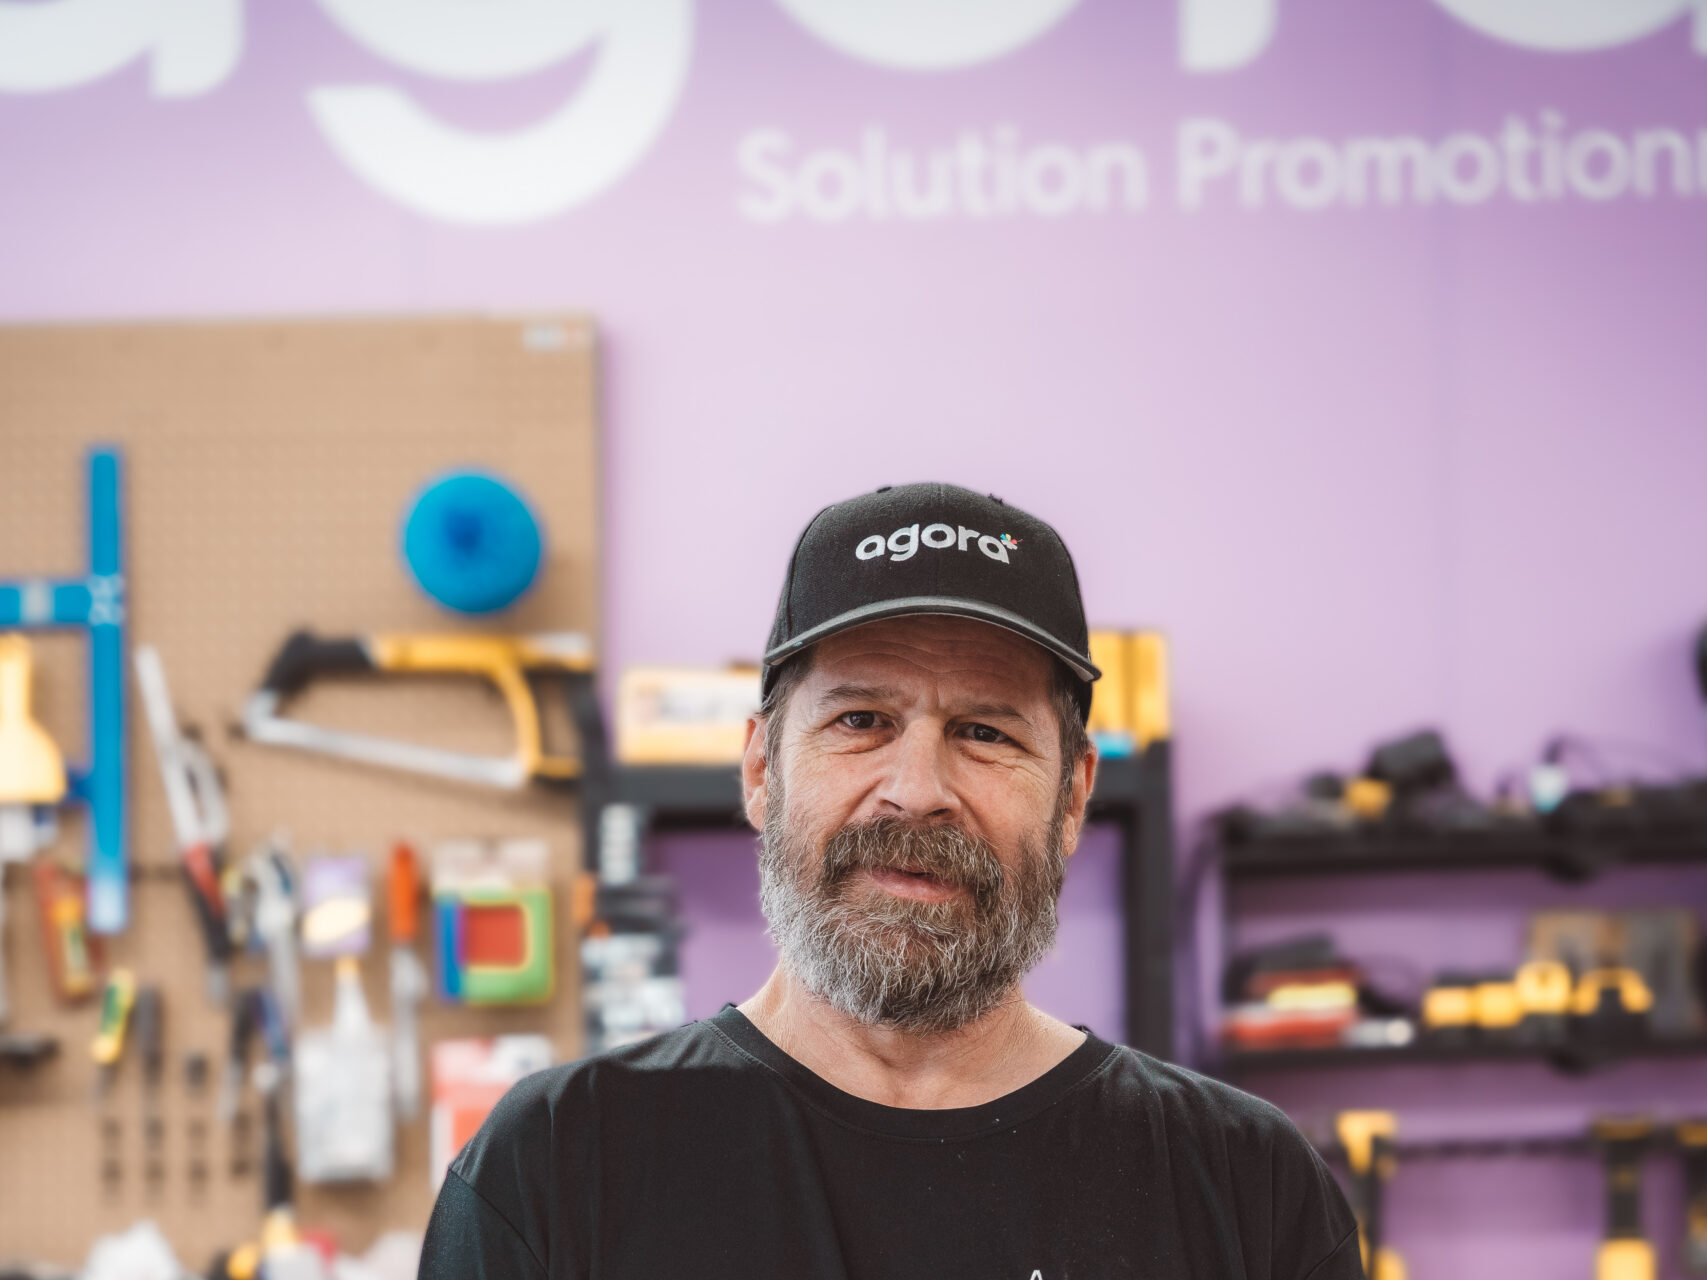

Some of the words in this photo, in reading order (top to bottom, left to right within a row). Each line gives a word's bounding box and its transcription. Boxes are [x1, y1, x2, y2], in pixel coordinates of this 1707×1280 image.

[736, 122, 1149, 223] Solution
[1177, 107, 1707, 208] Promotion
[855, 522, 1011, 565] agora
